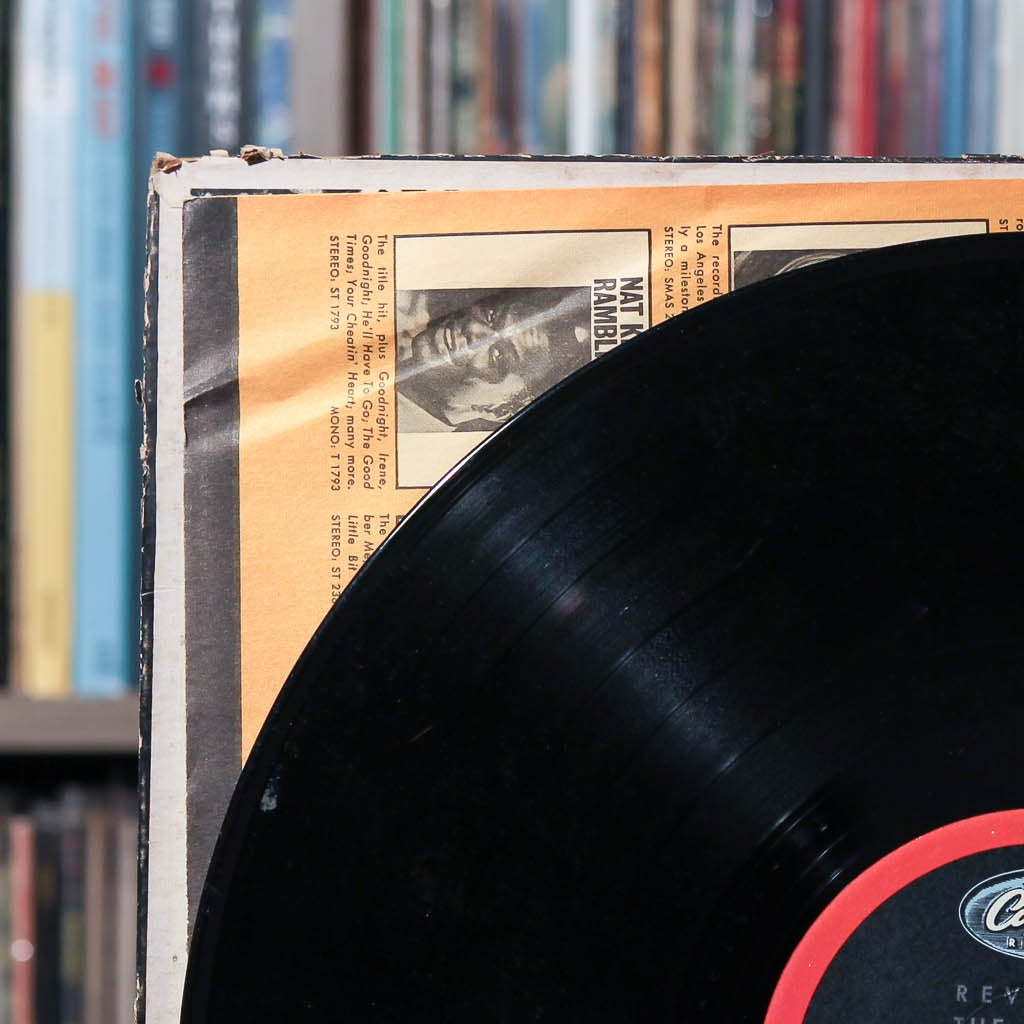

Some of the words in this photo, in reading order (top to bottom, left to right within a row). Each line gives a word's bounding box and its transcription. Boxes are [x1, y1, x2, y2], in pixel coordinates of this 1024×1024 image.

[377, 234, 388, 255] The
[696, 225, 707, 244] Los
[712, 224, 722, 246] The
[377, 267, 388, 291] title
[694, 252, 708, 302] Angeles
[330, 287, 340, 300] ST
[346, 280, 358, 307] Your
[620, 277, 643, 316] NAT
[665, 277, 674, 308] SMAS
[330, 305, 340, 331] 1793
[362, 310, 373, 339] He'll
[362, 344, 373, 376] Have
[375, 334, 388, 360] plus
[363, 382, 374, 394] To
[376, 371, 390, 441] Goodnight,
[344, 415, 355, 449] many
[362, 427, 374, 449] The
[330, 465, 341, 491] 1793
[347, 455, 355, 490] more.
[363, 455, 374, 490] Good
[348, 515, 359, 544] Little
[364, 514, 375, 535] ber
[379, 514, 390, 535] The
[331, 567, 341, 579] ST
[348, 555, 359, 571] Bit
